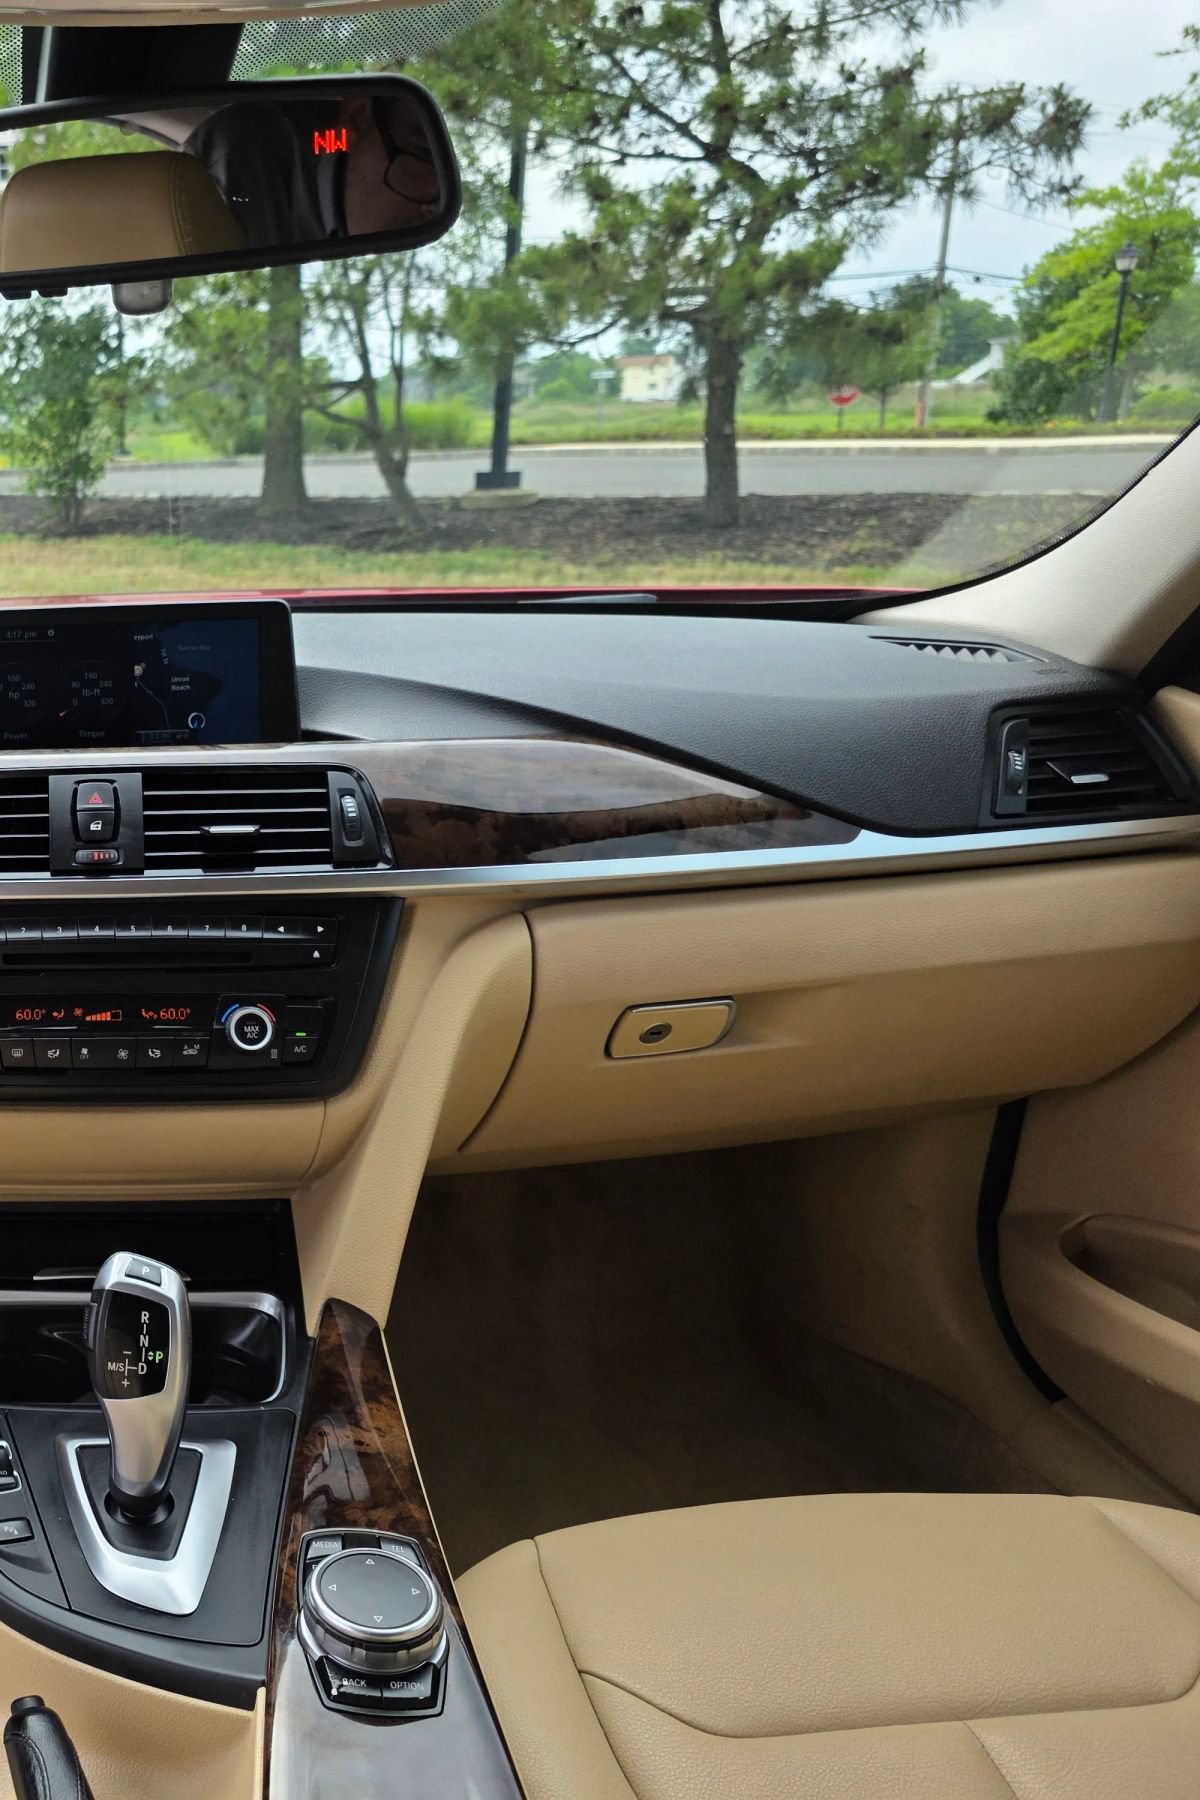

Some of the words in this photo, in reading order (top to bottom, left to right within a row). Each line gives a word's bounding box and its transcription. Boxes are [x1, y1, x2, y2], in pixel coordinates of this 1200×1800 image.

[314, 128, 347, 155] NW
[25, 630, 37, 641] pm
[9, 691, 20, 700] hp
[83, 689, 101, 697] lb-ft
[3, 732, 28, 741] Power
[79, 730, 105, 739] Torque
[56, 926, 62, 934] 3
[241, 924, 247, 932] 8
[142, 1266, 150, 1275] P
[140, 1311, 150, 1324] R
[140, 1334, 149, 1348] N
[156, 1351, 164, 1364] P
[108, 1362, 124, 1372] M/S
[138, 1362, 147, 1374] D
[312, 1540, 339, 1549] MEDIA
[392, 1545, 404, 1553] TEL
[342, 1678, 367, 1687] BACK
[390, 1681, 424, 1690] OPTION
